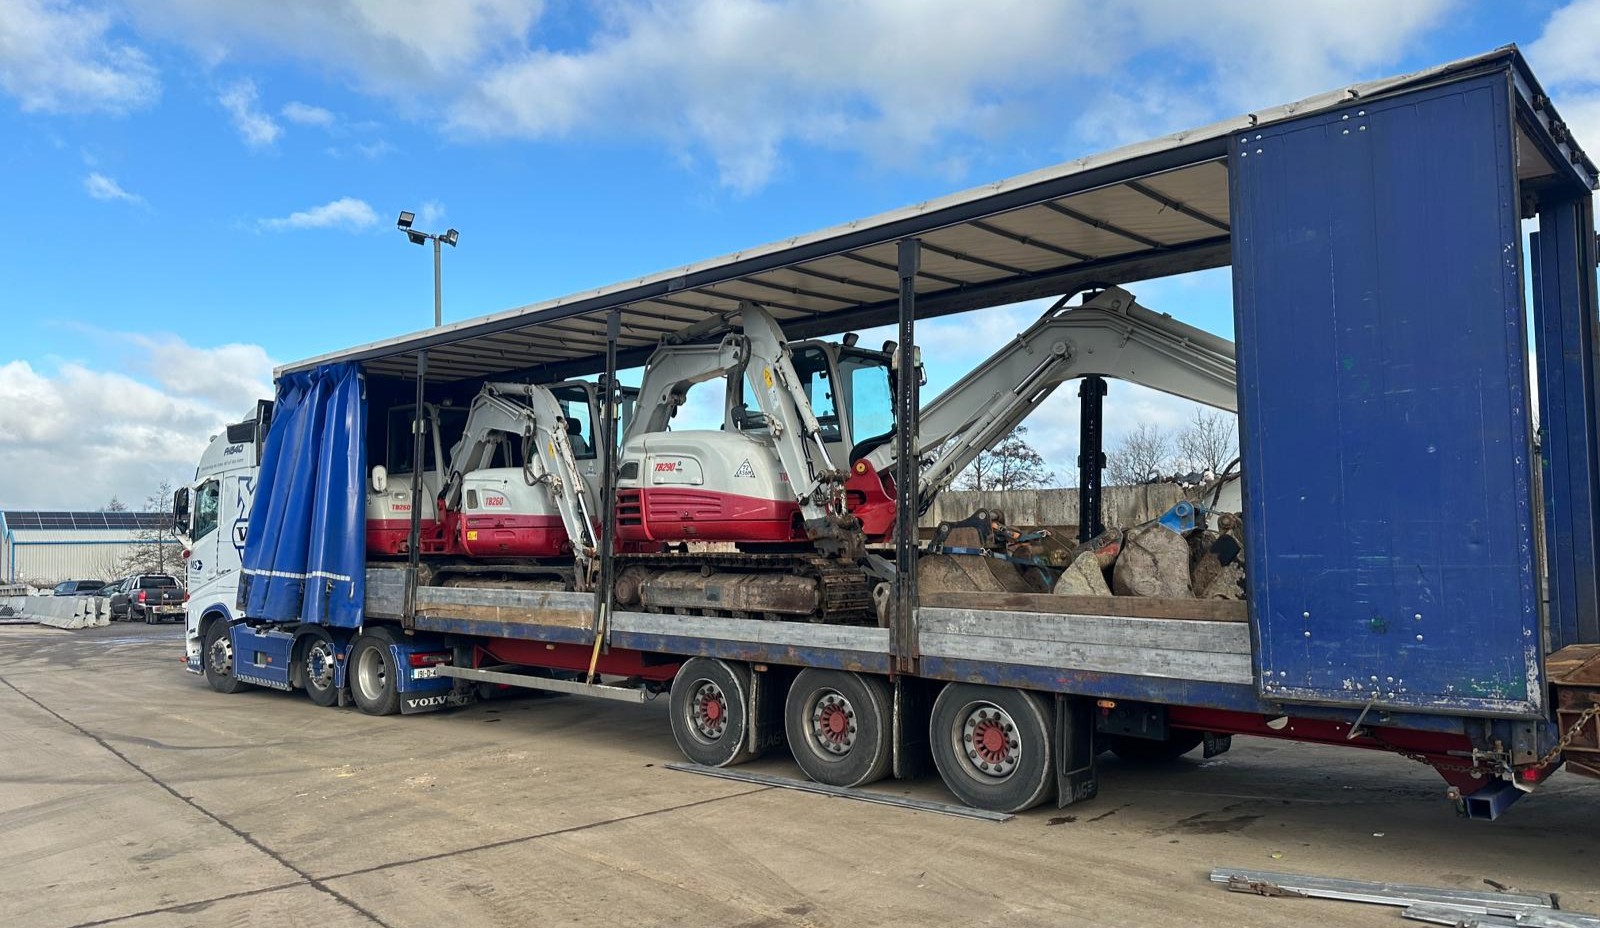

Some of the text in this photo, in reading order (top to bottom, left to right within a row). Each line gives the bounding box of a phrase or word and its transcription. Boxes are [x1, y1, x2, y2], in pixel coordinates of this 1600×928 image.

[655, 463, 676, 472] TB290
[485, 497, 504, 506] TB260
[407, 696, 448, 708] VOLV
